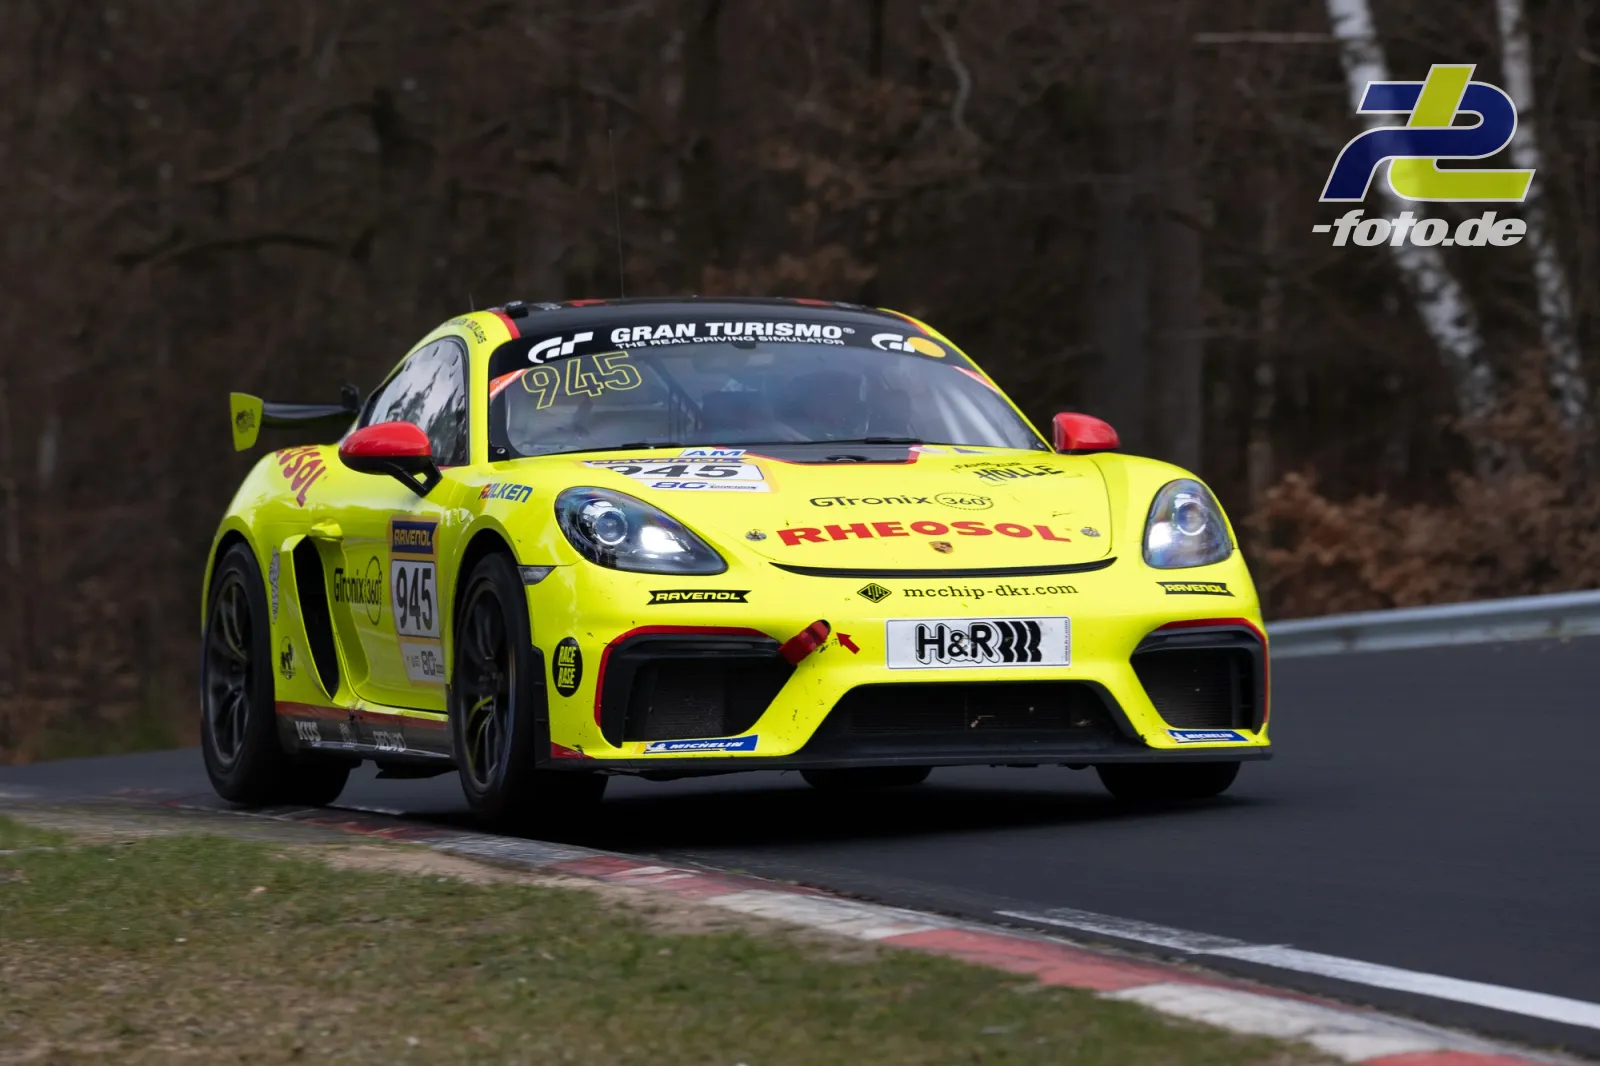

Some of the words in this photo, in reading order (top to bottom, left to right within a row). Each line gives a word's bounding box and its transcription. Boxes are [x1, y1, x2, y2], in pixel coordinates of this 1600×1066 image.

[610, 323, 697, 344] GRAN
[616, 340, 647, 350] THE
[650, 336, 690, 346] REAL
[693, 334, 754, 344] DRIVING
[758, 335, 845, 347] SIMULATOR
[521, 350, 642, 410] 945
[394, 529, 432, 546] RAVENOL
[776, 520, 1072, 547] RHEOSOL
[396, 566, 433, 631] 945
[656, 591, 741, 602] RAVENOL
[903, 583, 1079, 600] mcchip-dkr.com
[1163, 583, 1228, 595] RAVENOL
[916, 621, 999, 664] H&R
[558, 645, 577, 666] RACE
[558, 667, 576, 688] BASE
[669, 740, 745, 750] MICHELIN
[1184, 732, 1234, 740] MICHELIN
